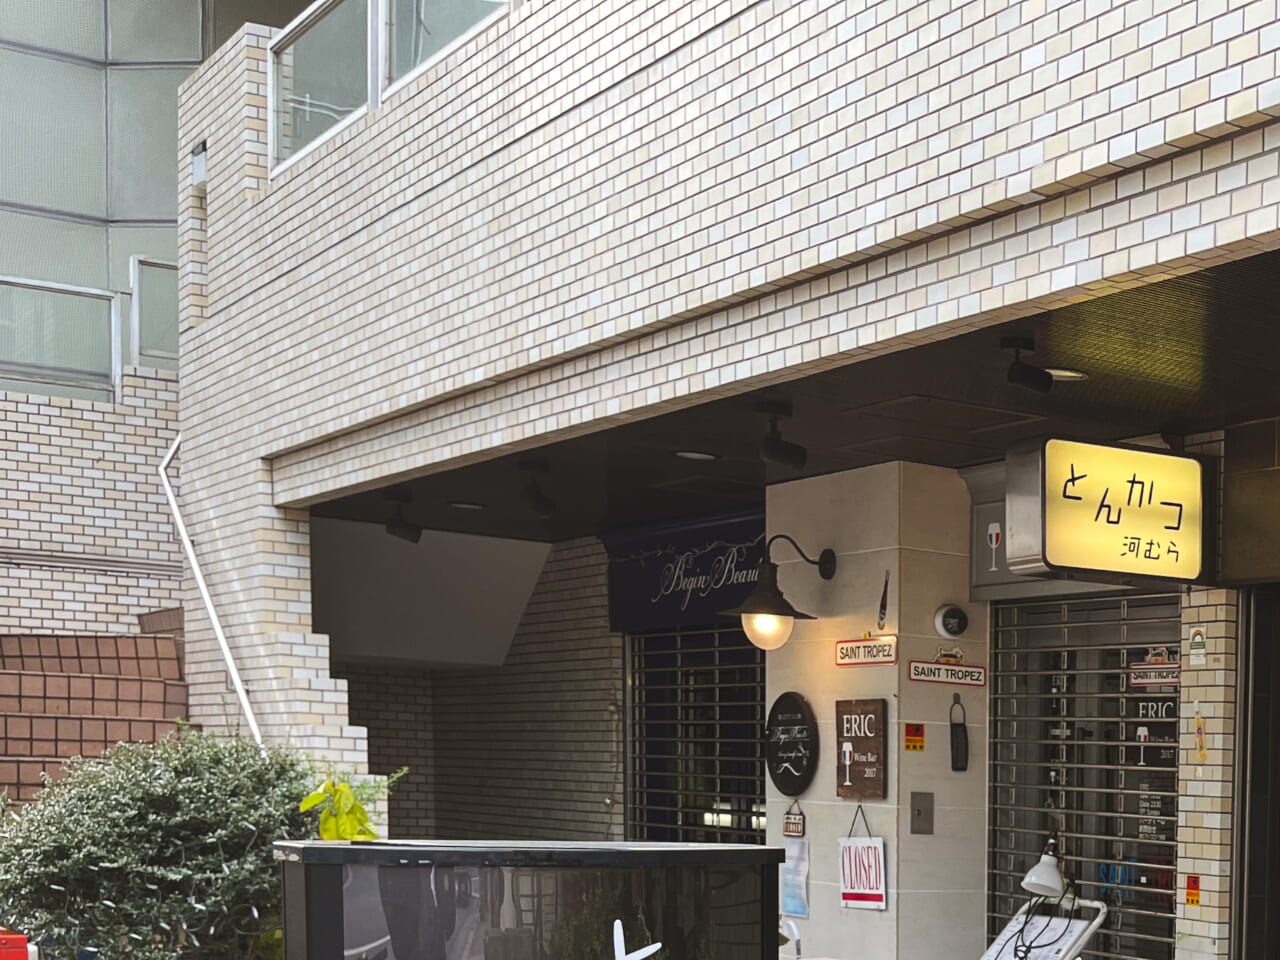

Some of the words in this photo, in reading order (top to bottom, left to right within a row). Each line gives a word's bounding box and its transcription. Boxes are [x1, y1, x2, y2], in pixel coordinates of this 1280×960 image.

[1062, 463, 1184, 531] とんかつ
[1120, 536, 1180, 563] 河むら
[651, 552, 711, 611] Begin
[840, 646, 861, 660] SAINT
[863, 644, 893, 658] TROPEZ
[913, 665, 942, 679] SAINT
[944, 668, 983, 682] TROPEZ
[842, 713, 875, 738] ERIC
[854, 752, 867, 762] Wine
[864, 767, 877, 777] 2017
[841, 846, 882, 890] CLOSED
